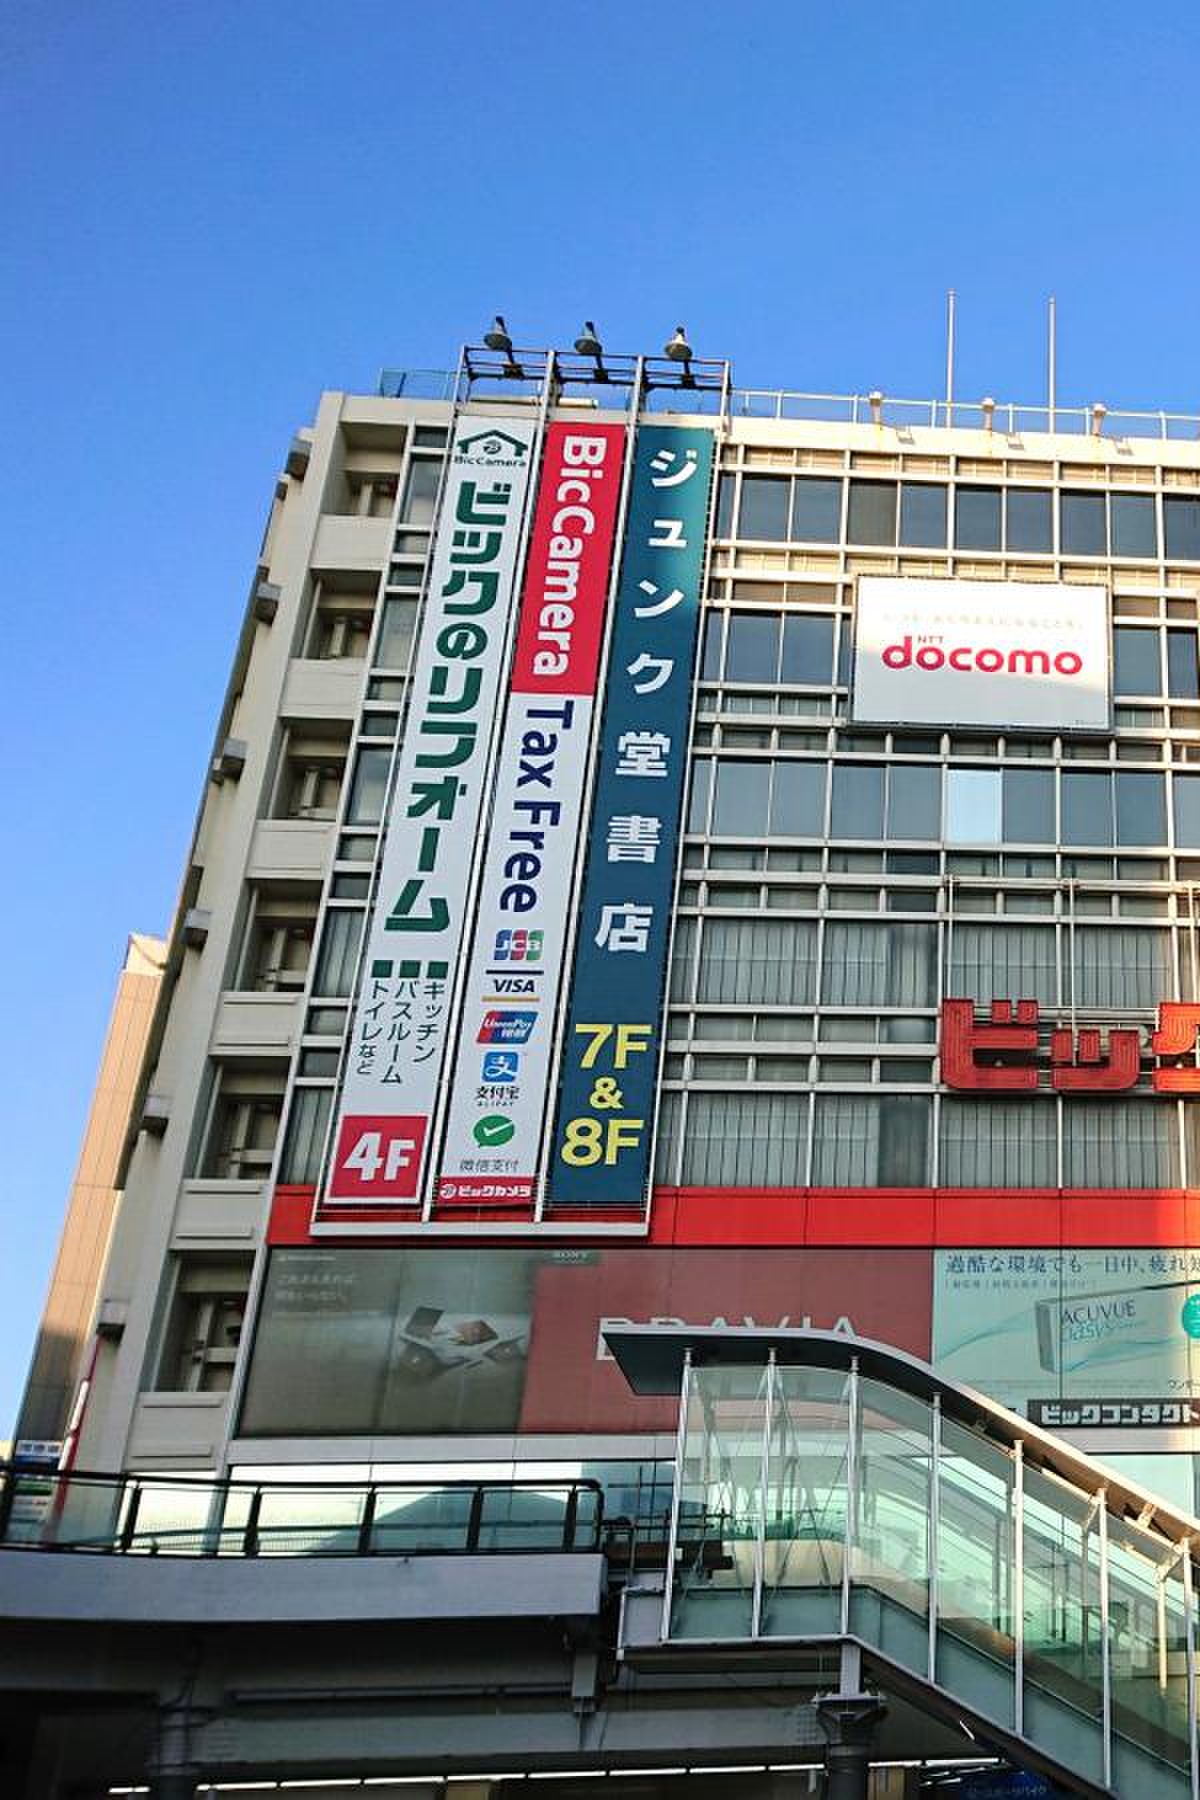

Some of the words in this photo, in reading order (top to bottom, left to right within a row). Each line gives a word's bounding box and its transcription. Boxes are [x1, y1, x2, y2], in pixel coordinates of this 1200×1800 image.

[531, 435, 608, 677] BicCamera
[881, 635, 1084, 676] docomo
[383, 481, 512, 933] ビックのリフォーム
[594, 449, 699, 953] ジュンク堂書店
[516, 700, 575, 789] Tax
[500, 799, 562, 914] Free
[494, 930, 545, 961] JCB
[492, 978, 536, 993] VISA
[356, 980, 390, 1076] トイレなど
[381, 979, 418, 1085] バスルーム
[413, 980, 446, 1064] キッチン
[575, 1023, 654, 1070] 7F
[342, 1131, 418, 1182] 4F
[560, 1117, 645, 1167] 8F
[457, 1184, 532, 1198] ビックカメラ
[1063, 1299, 1136, 1325] ACUVUE
[1041, 1403, 1200, 1424] ビックコンタクト
